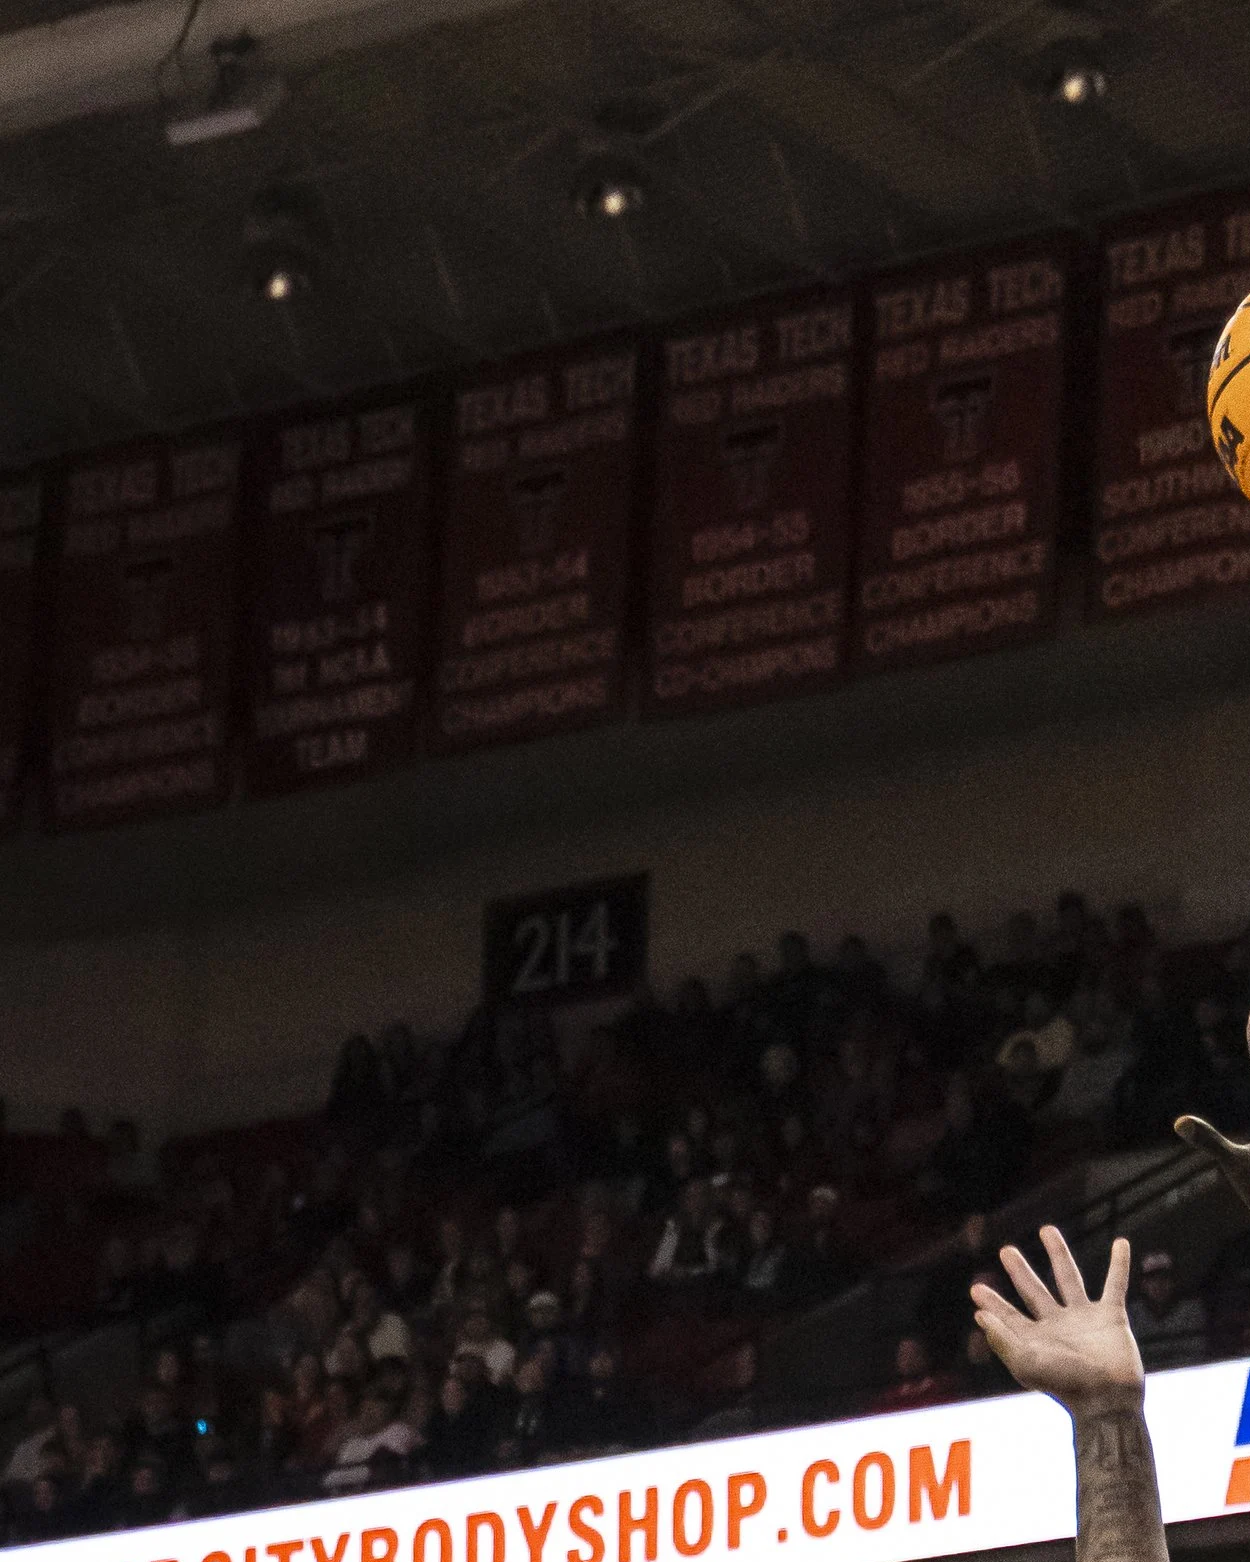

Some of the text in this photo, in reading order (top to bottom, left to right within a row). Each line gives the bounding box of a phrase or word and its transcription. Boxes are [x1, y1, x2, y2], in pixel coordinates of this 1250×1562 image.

[1107, 224, 1204, 285] TEXAS
[874, 256, 1061, 336] TEXAS TECH
[1106, 291, 1161, 329] RED
[665, 304, 850, 384] TEXAS TECH
[876, 314, 1057, 380] RED RAIDERS
[456, 355, 633, 432] TEXAS TECH
[671, 364, 844, 426] RED RAIDERS
[1104, 463, 1235, 516] SOUTHW
[893, 503, 1024, 557] BORDER
[683, 552, 814, 605] BORDER
[862, 543, 1044, 606] CONFERENCE
[656, 591, 842, 654] CONFERENCE
[866, 592, 1036, 652] CHAMPIONS
[440, 631, 615, 689] CONFERENCE
[441, 676, 606, 733] CHAMPIONS
[297, 728, 366, 769] TEAM
[511, 900, 619, 993] 214
